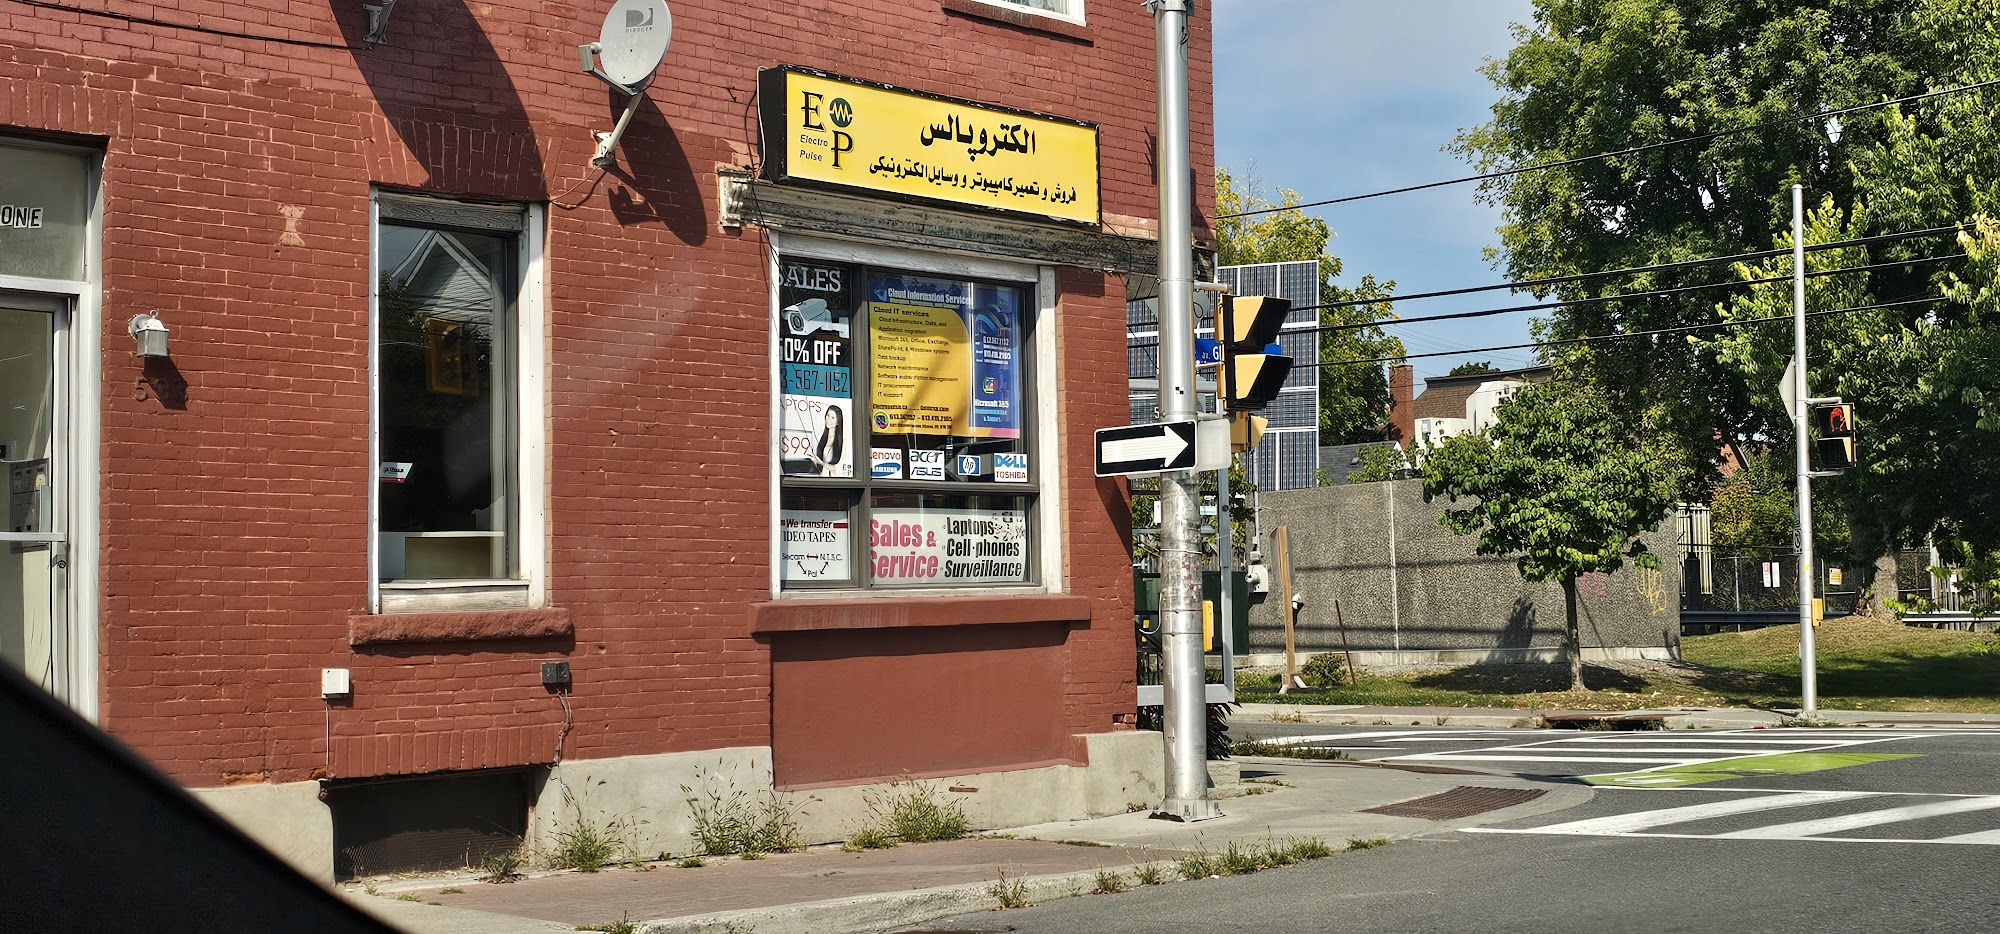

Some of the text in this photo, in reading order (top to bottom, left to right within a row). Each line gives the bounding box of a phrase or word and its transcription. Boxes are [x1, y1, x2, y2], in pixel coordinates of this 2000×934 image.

[801, 90, 825, 131] E
[800, 133, 828, 147] Electro
[800, 149, 823, 162] Pulse
[831, 130, 854, 170] P
[929, 166, 959, 187] وسایل
[960, 174, 967, 188] و
[1012, 181, 1040, 198] تعمیر
[1042, 188, 1048, 200] و
[1050, 183, 1077, 204] فروش
[1, 206, 42, 227] ONE
[780, 265, 842, 292] ALES
[888, 287, 907, 299] Cloud
[907, 290, 945, 302] Information
[873, 306, 892, 314] Cloud
[901, 309, 930, 317] services
[878, 326, 904, 334] Application
[779, 337, 842, 365] 0% OFF
[781, 435, 811, 455] $99
[910, 451, 943, 463] acer
[964, 457, 974, 472] hp
[994, 454, 1027, 469] DELL
[995, 471, 1026, 479] TOSHIBA
[786, 519, 834, 529] We transfer
[946, 517, 995, 537] Laptops
[781, 530, 837, 542] IDEO TAPES
[870, 518, 937, 547] Sales &
[870, 550, 938, 578] Service
[944, 559, 1022, 578] Surveillance
